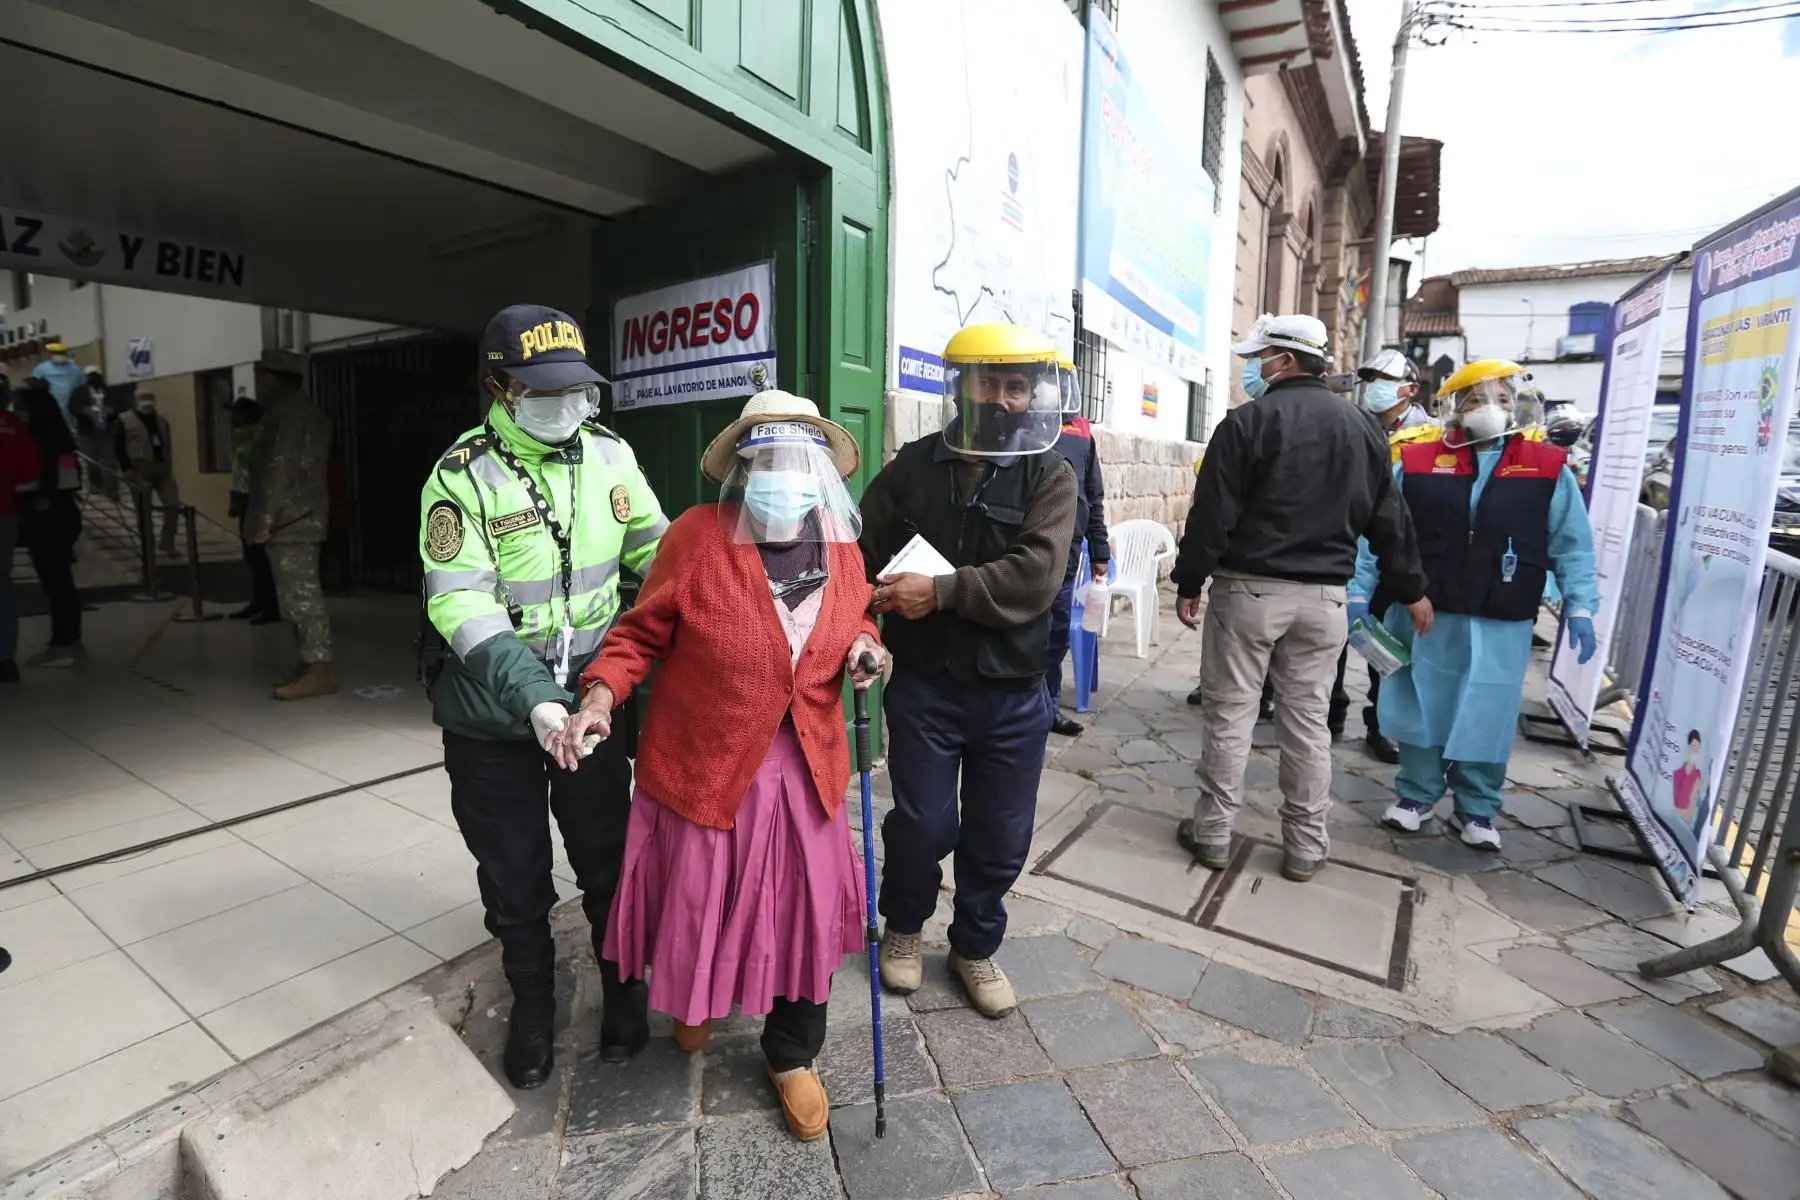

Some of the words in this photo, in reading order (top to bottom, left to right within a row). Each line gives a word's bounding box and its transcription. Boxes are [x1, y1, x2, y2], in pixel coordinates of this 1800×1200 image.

[118, 233, 144, 271] Y
[156, 241, 245, 287] BIEN
[621, 292, 759, 361] INGRESO
[636, 388, 653, 400] PASE
[653, 387, 663, 397] AL
[664, 381, 704, 396] LAVATORIO
[706, 379, 717, 390] DE
[718, 375, 747, 389] MANOS
[757, 425, 785, 437] Face
[789, 423, 821, 438] Shield
[1720, 445, 1748, 456] genes
